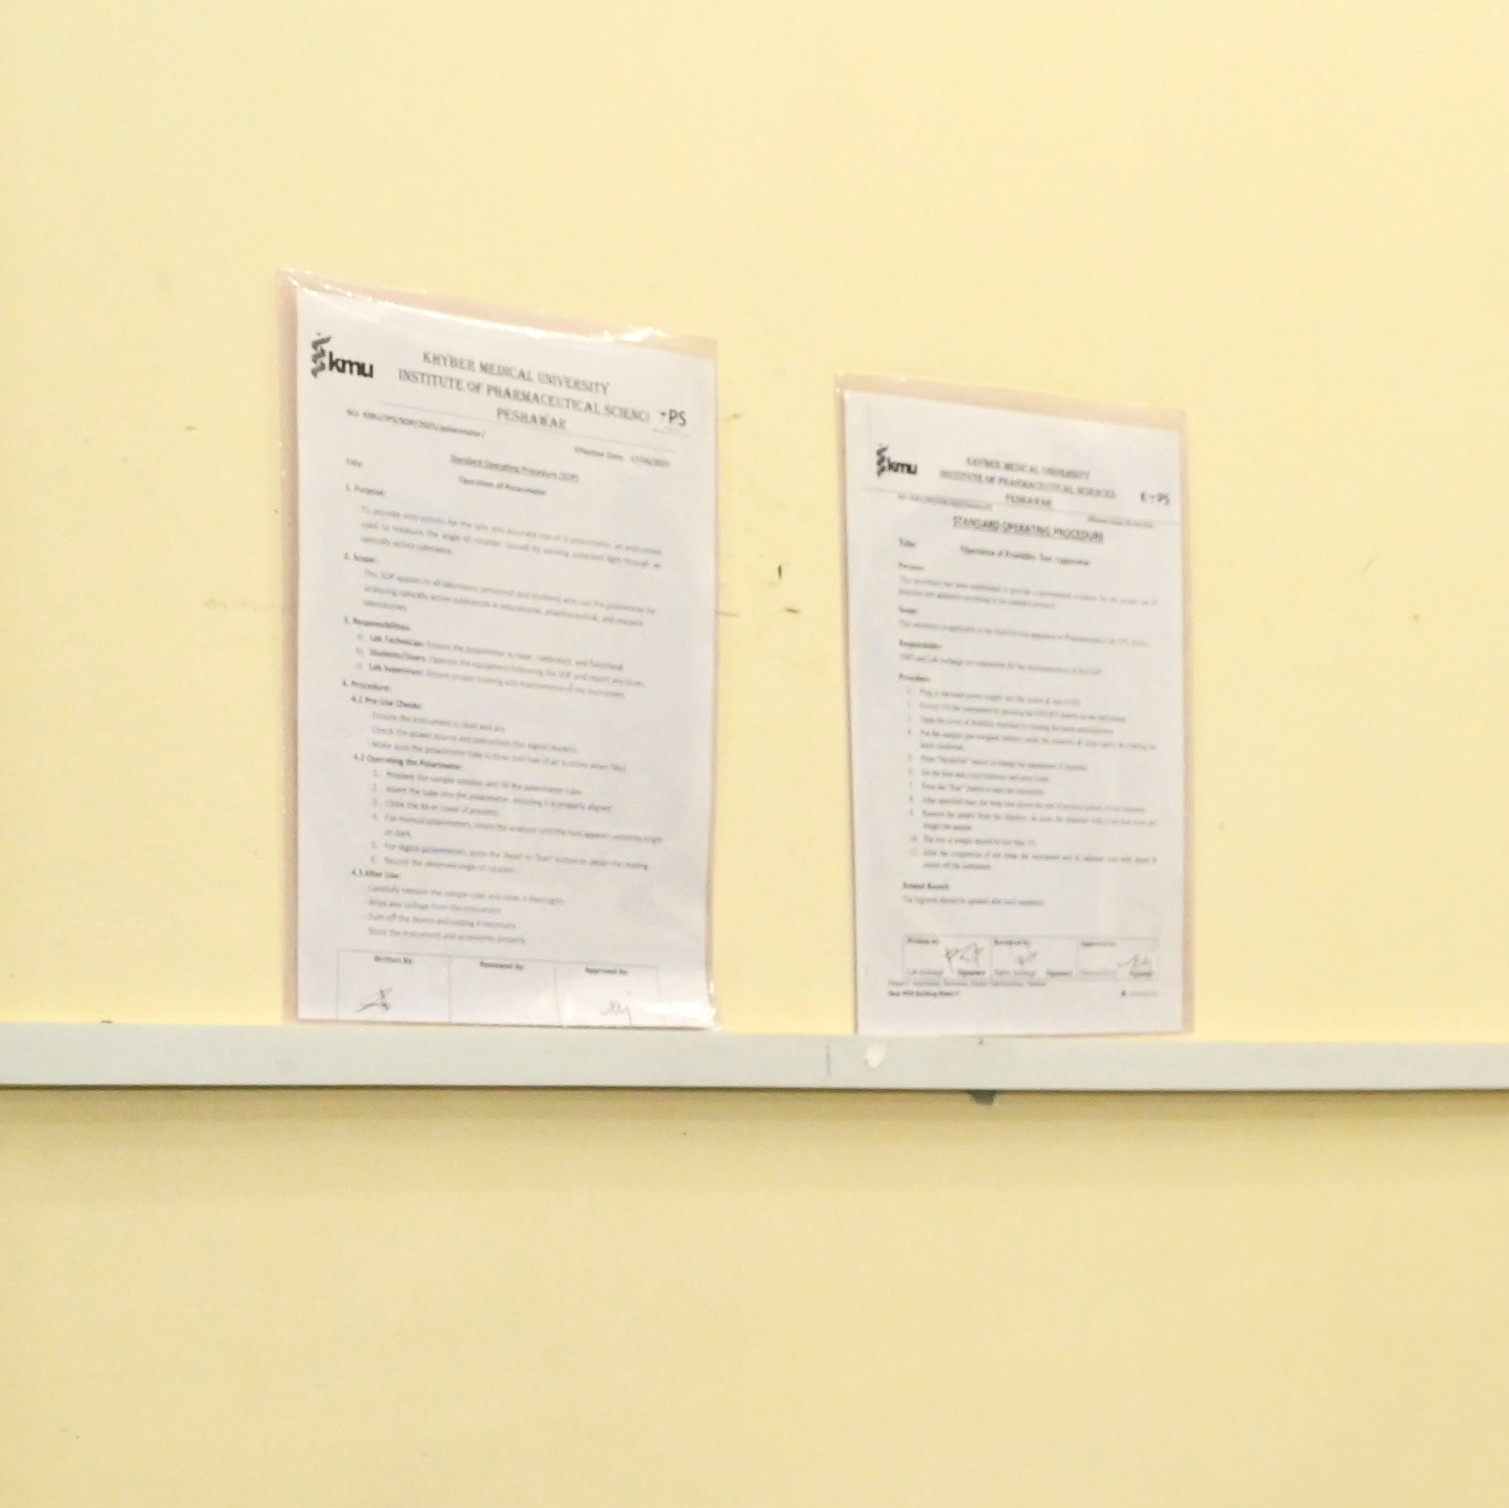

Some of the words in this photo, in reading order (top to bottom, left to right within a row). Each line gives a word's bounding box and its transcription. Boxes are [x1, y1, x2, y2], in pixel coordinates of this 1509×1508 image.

[328, 351, 374, 378] kmu
[423, 351, 475, 371] KHYBER
[480, 360, 534, 382] MEDICAL
[537, 371, 610, 395] UNIVERSITY
[399, 368, 463, 391] INSTITUTE
[467, 380, 483, 395] OF
[487, 384, 600, 415] PHARMACEUTICAL
[496, 407, 566, 430] PESHAWAR
